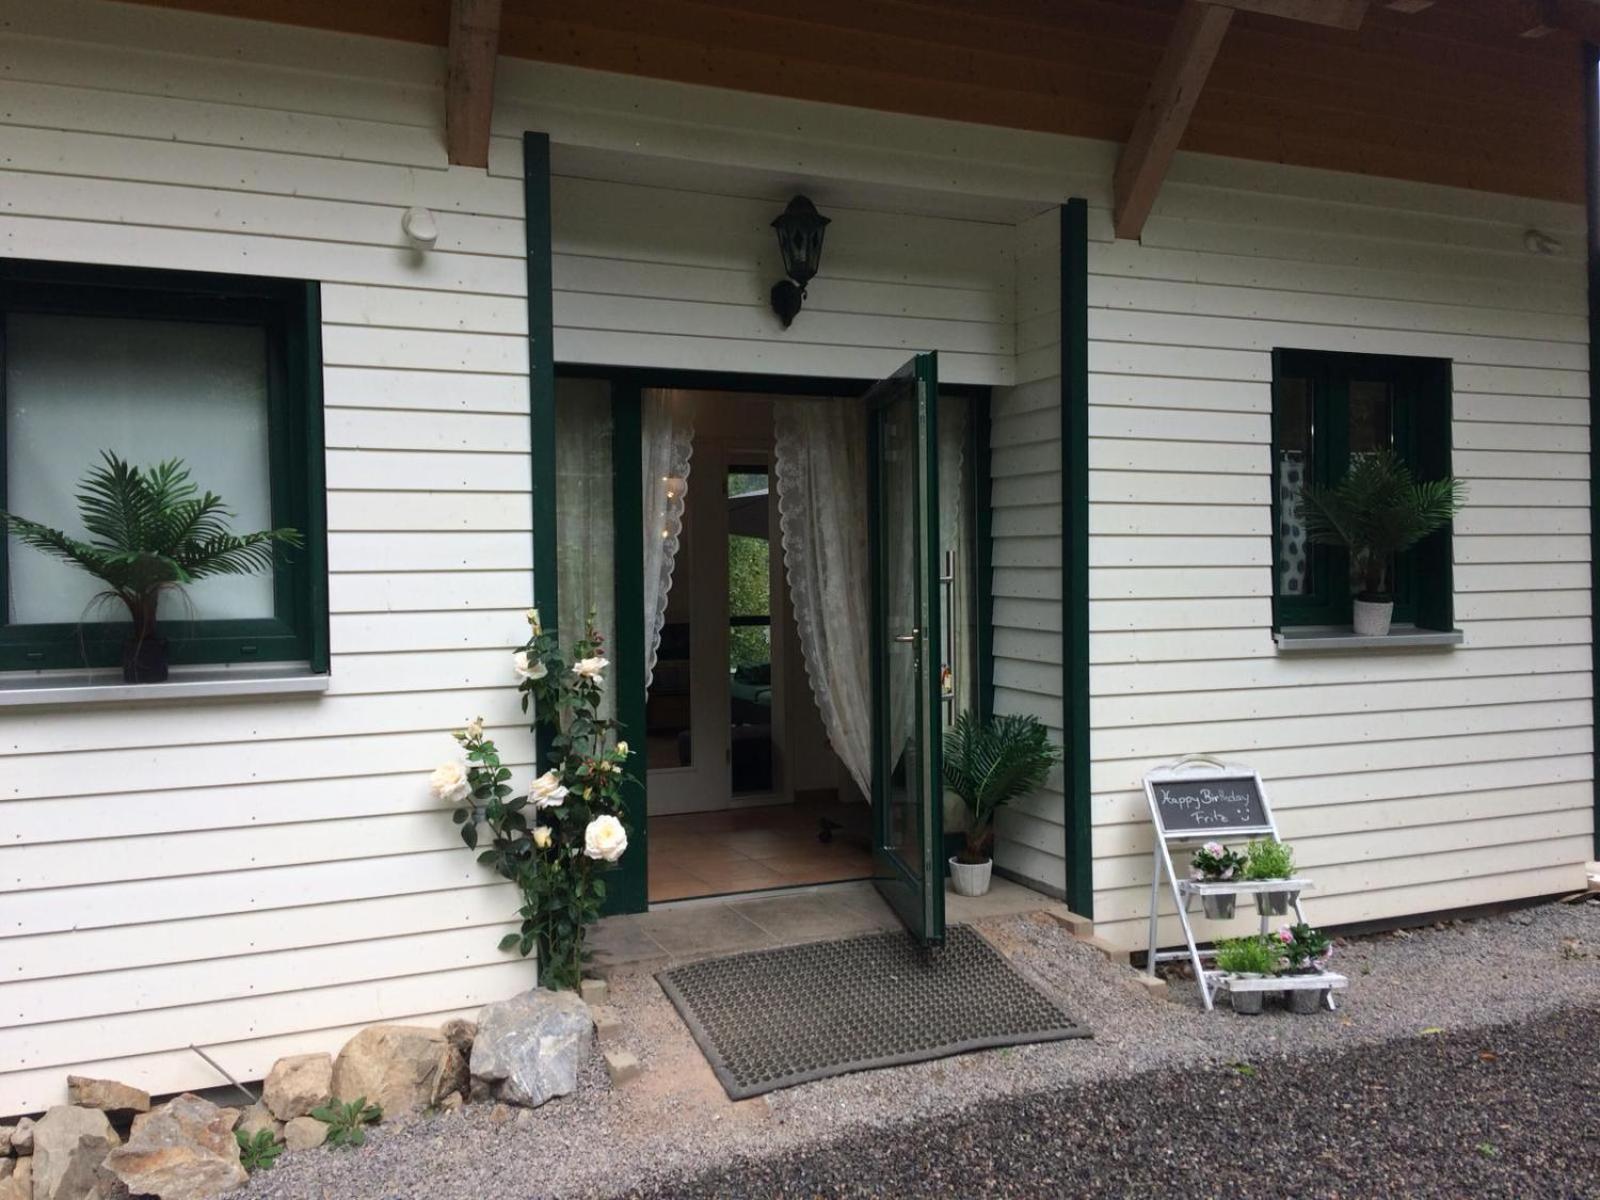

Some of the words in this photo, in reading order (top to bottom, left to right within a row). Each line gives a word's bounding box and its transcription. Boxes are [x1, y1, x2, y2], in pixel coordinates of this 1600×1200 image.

[1161, 789, 1200, 809] Happy
[1200, 789, 1249, 806] Birthday
[1191, 809, 1229, 824] Fritz
